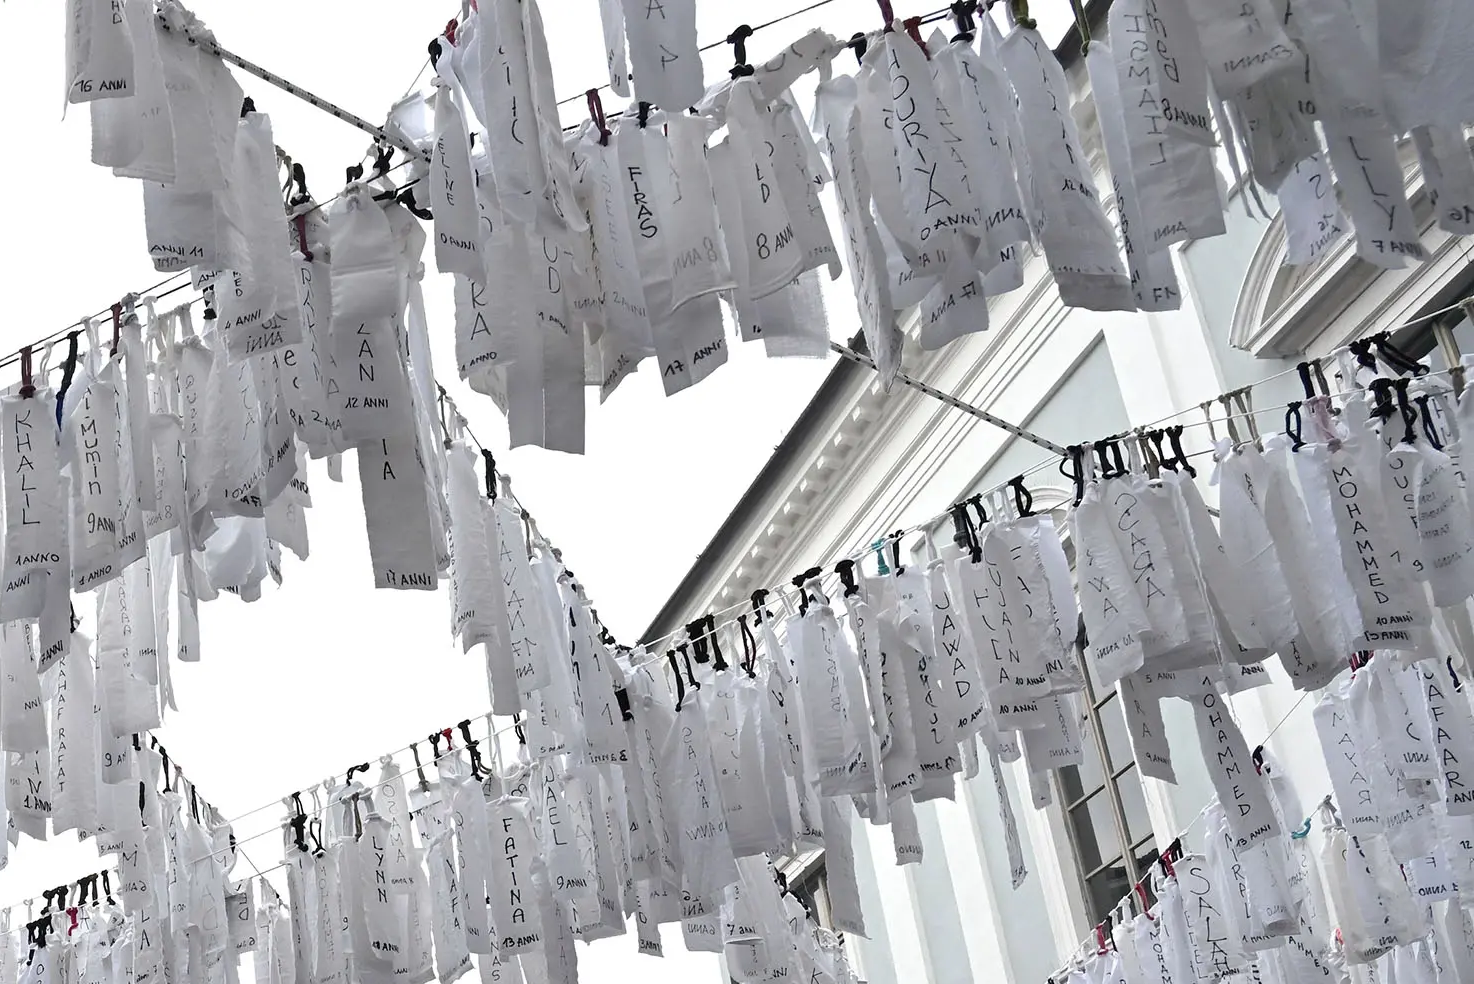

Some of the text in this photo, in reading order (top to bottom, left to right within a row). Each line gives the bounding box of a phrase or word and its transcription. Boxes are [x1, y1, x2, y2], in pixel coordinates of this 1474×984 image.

[73, 77, 129, 94] 16 ANNI
[627, 166, 659, 239] FIRAS
[756, 232, 771, 260] 8
[235, 311, 263, 327] ANNI
[470, 352, 498, 369] ANNO
[663, 338, 724, 378] 17 ANNI
[362, 397, 389, 410] ANNI
[14, 410, 41, 526] KHALIL
[1333, 465, 1390, 606] MOHAMMED
[399, 571, 433, 587] ANNI
[935, 590, 974, 699] JAWAD
[1157, 671, 1177, 683] ANNI
[1014, 703, 1039, 715] ANNI
[55, 726, 69, 795] RAFAT
[372, 835, 390, 906] LYNN
[502, 818, 527, 934] FATINA
[1287, 934, 1331, 978] AHMED
